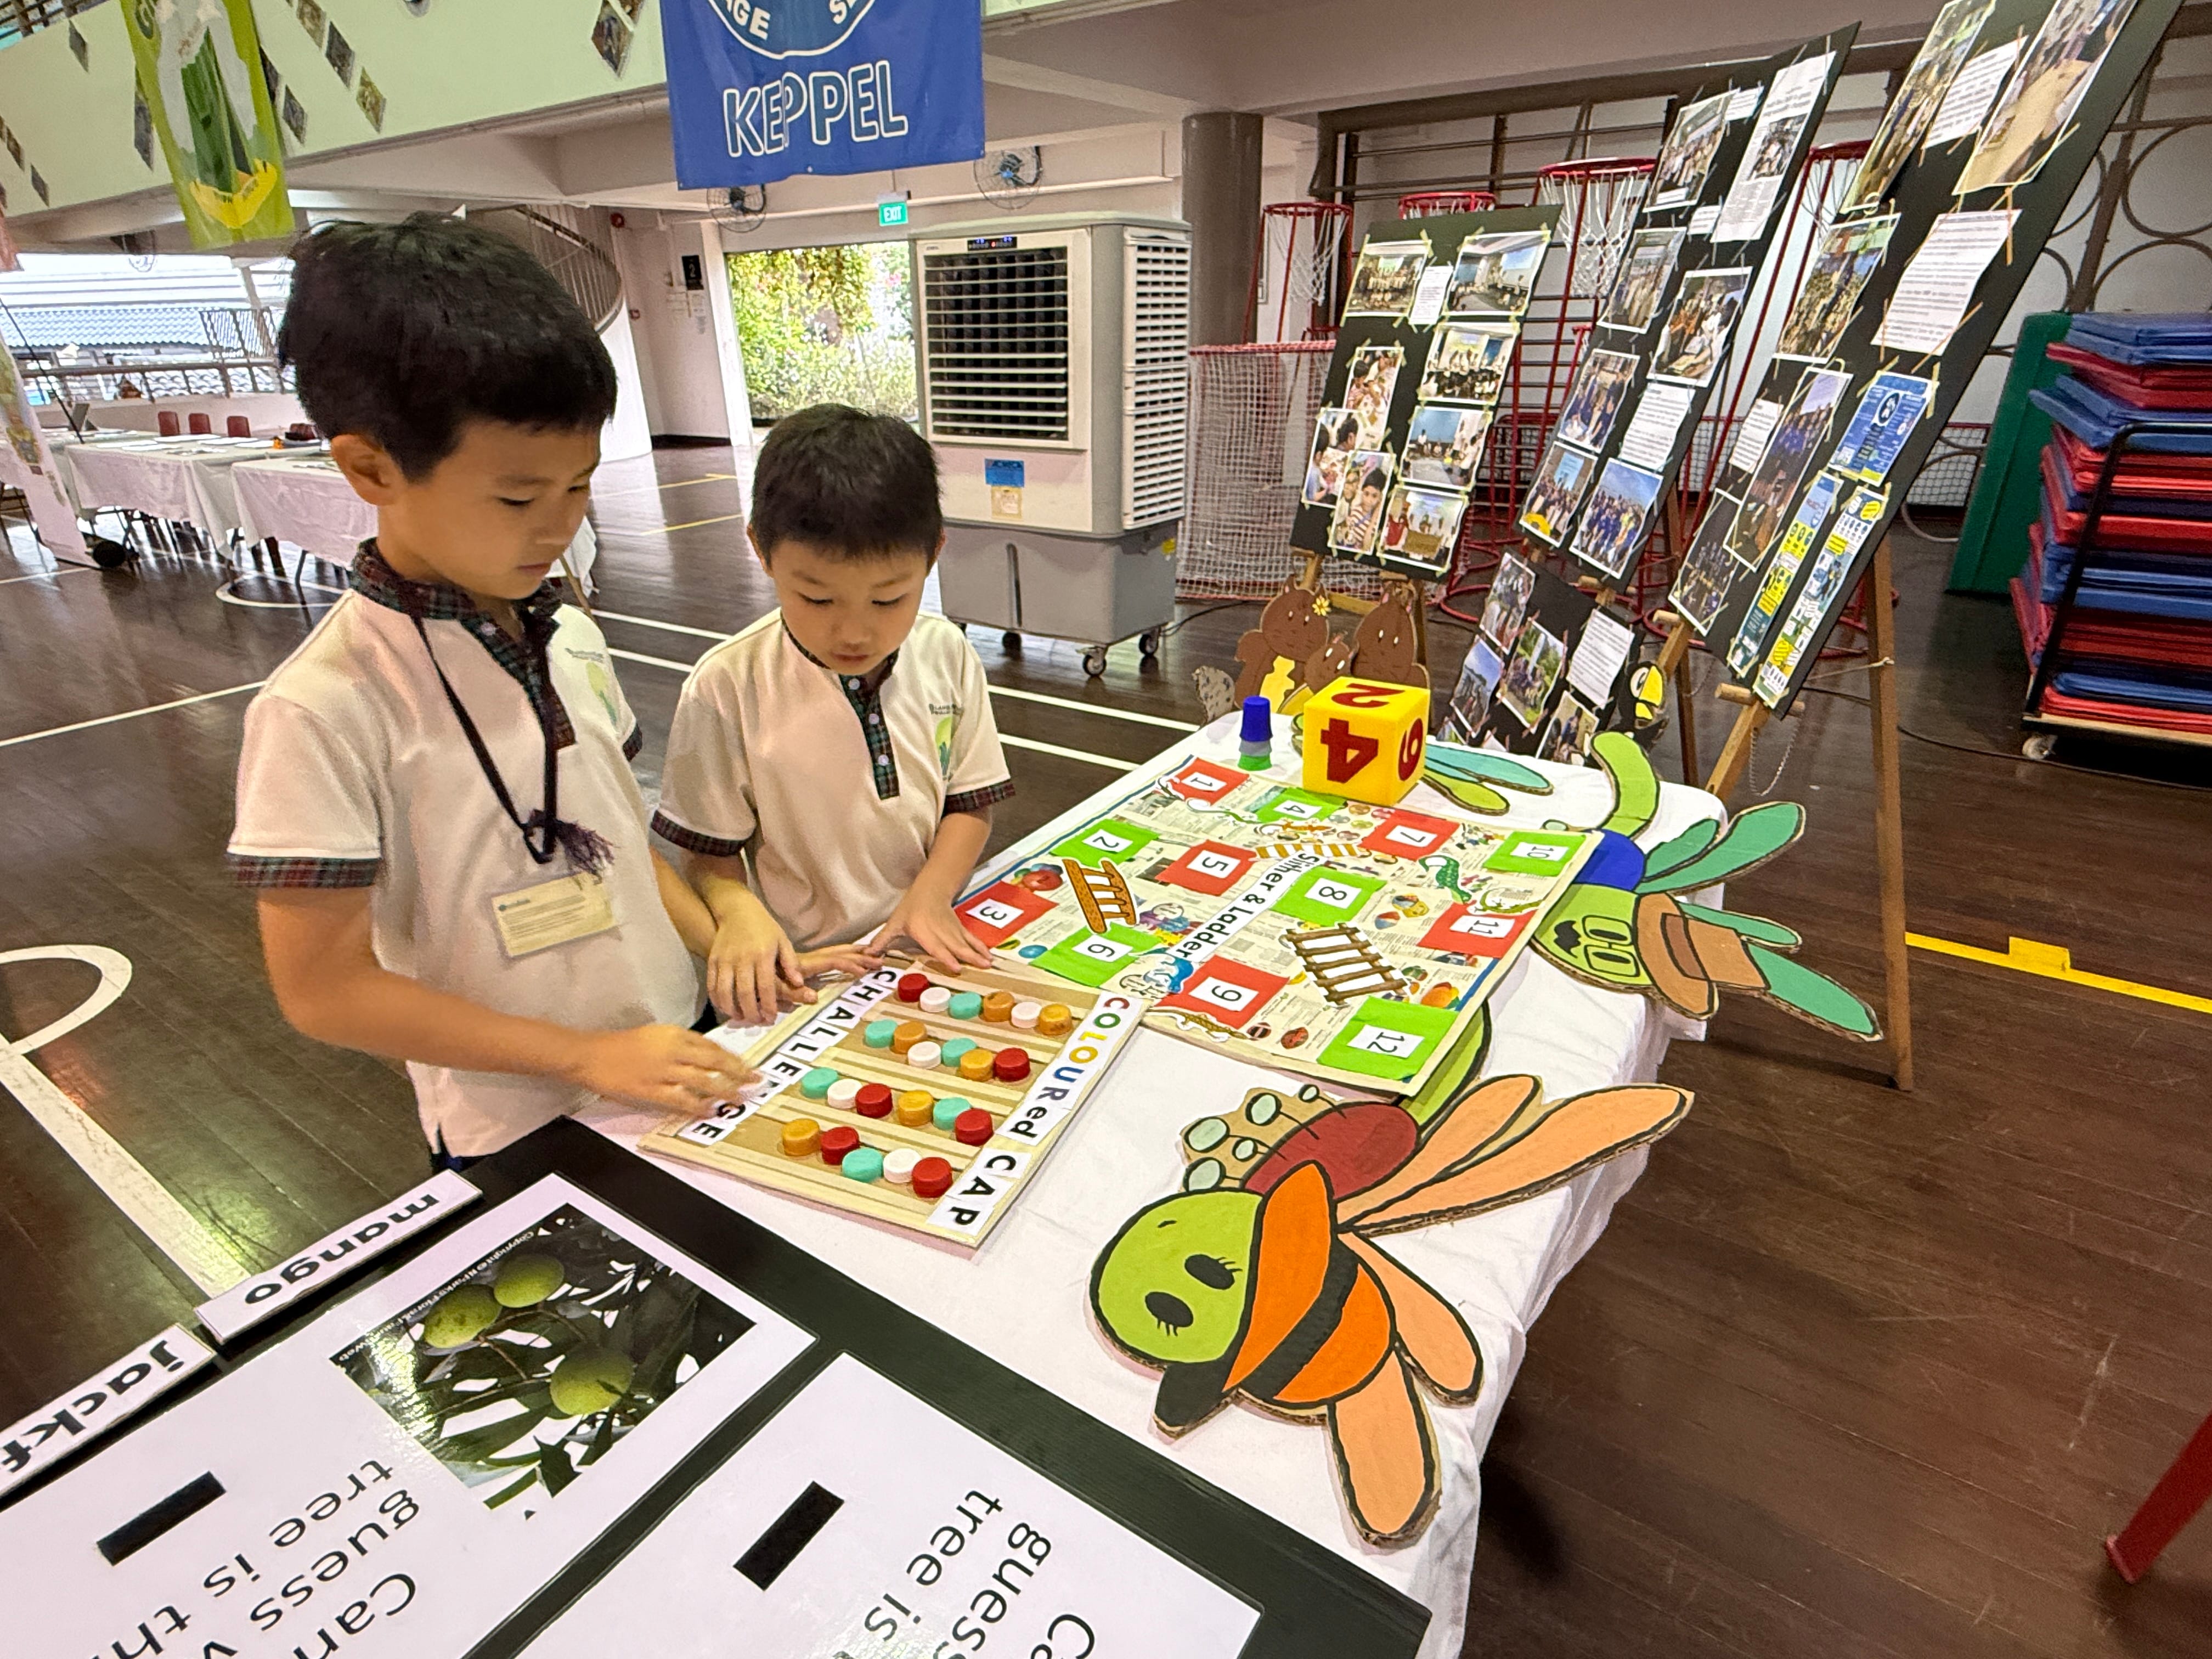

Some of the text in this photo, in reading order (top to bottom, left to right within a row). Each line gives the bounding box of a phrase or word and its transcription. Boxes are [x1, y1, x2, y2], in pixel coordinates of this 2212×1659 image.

[724, 61, 908, 157] KEPPEL
[884, 205, 902, 222] EXIT
[1331, 683, 1406, 708] 2
[1321, 718, 1379, 783] 4
[1191, 777, 1213, 787] 1
[1283, 803, 1306, 814] 4
[1093, 837, 1119, 848] 2
[1403, 831, 1426, 843] 7
[1530, 846, 1549, 860] 10
[1202, 857, 1228, 871] 5
[1243, 893, 1266, 905] &
[1319, 887, 1347, 900] 8
[980, 907, 1007, 920] 3
[1176, 906, 1253, 960] Ladder
[1469, 918, 1499, 935] 11
[1087, 944, 1115, 957] 6
[1211, 986, 1242, 1002] 9
[1367, 1032, 1404, 1052] 12
[692, 970, 896, 1138] CHALLEGE
[948, 996, 1131, 1226] COLOURed CAP
[245, 1193, 440, 1305] mango
[91, 1460, 393, 1659] tree is th
[250, 1490, 419, 1630] guess
[864, 1491, 1003, 1641] tree is
